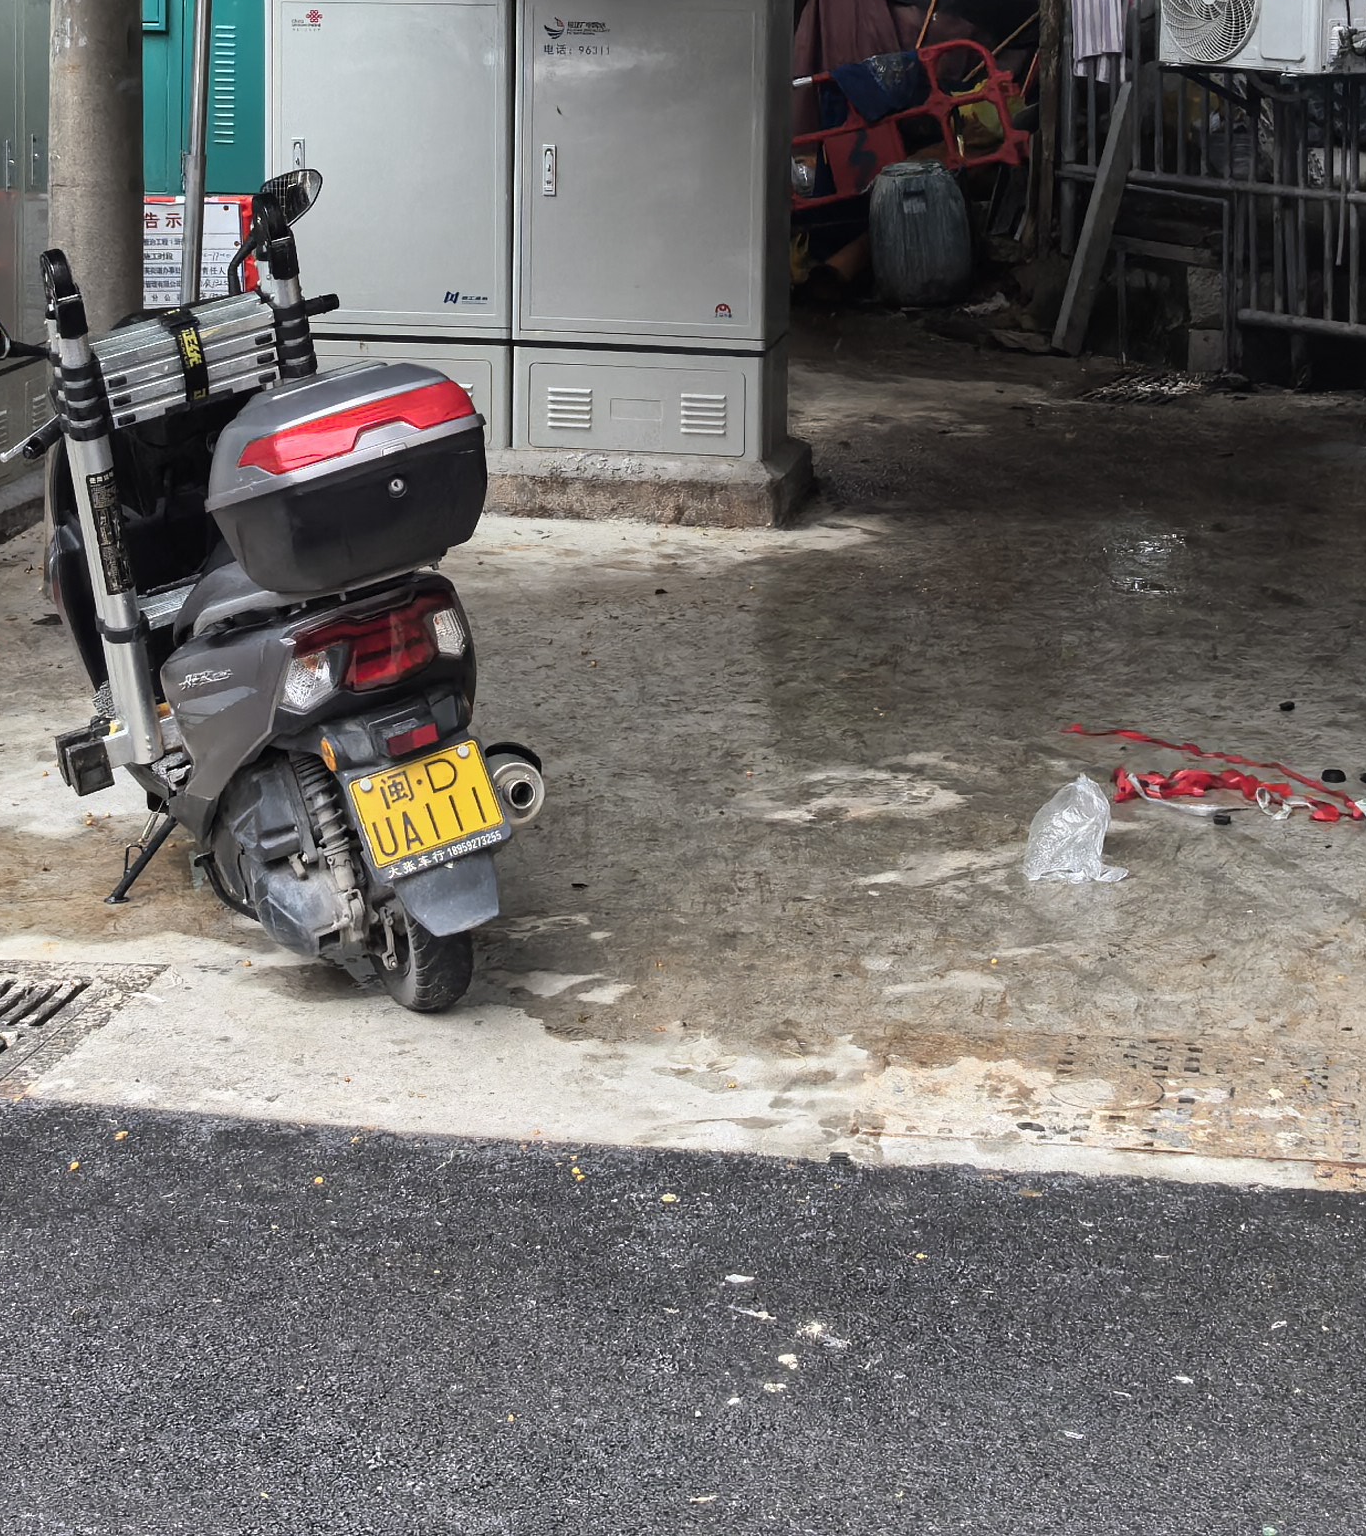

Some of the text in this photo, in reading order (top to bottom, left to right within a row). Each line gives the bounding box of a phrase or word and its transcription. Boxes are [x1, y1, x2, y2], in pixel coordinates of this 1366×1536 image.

[387, 829, 503, 880] 大张车行 18959273255
